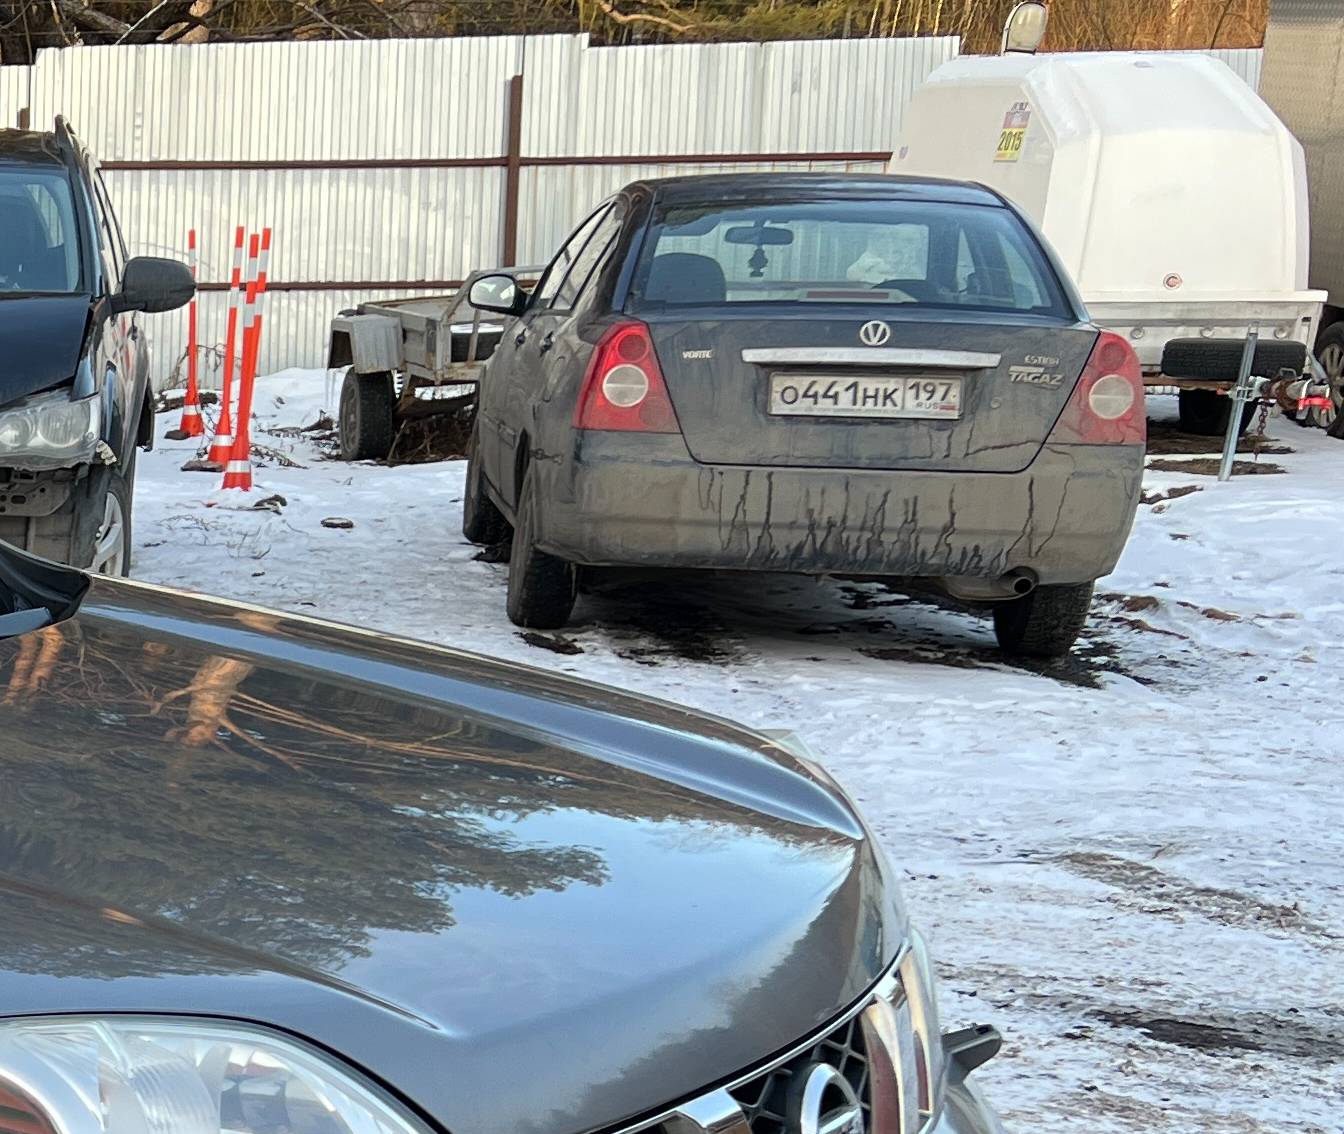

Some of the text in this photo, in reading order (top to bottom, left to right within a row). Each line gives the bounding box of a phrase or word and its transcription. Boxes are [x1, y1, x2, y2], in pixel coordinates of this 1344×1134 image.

[997, 131, 1024, 151] 2015
[1009, 372, 1064, 385] TAGAZ
[780, 380, 954, 407] О441НК 197
[915, 402, 938, 410] RUS
